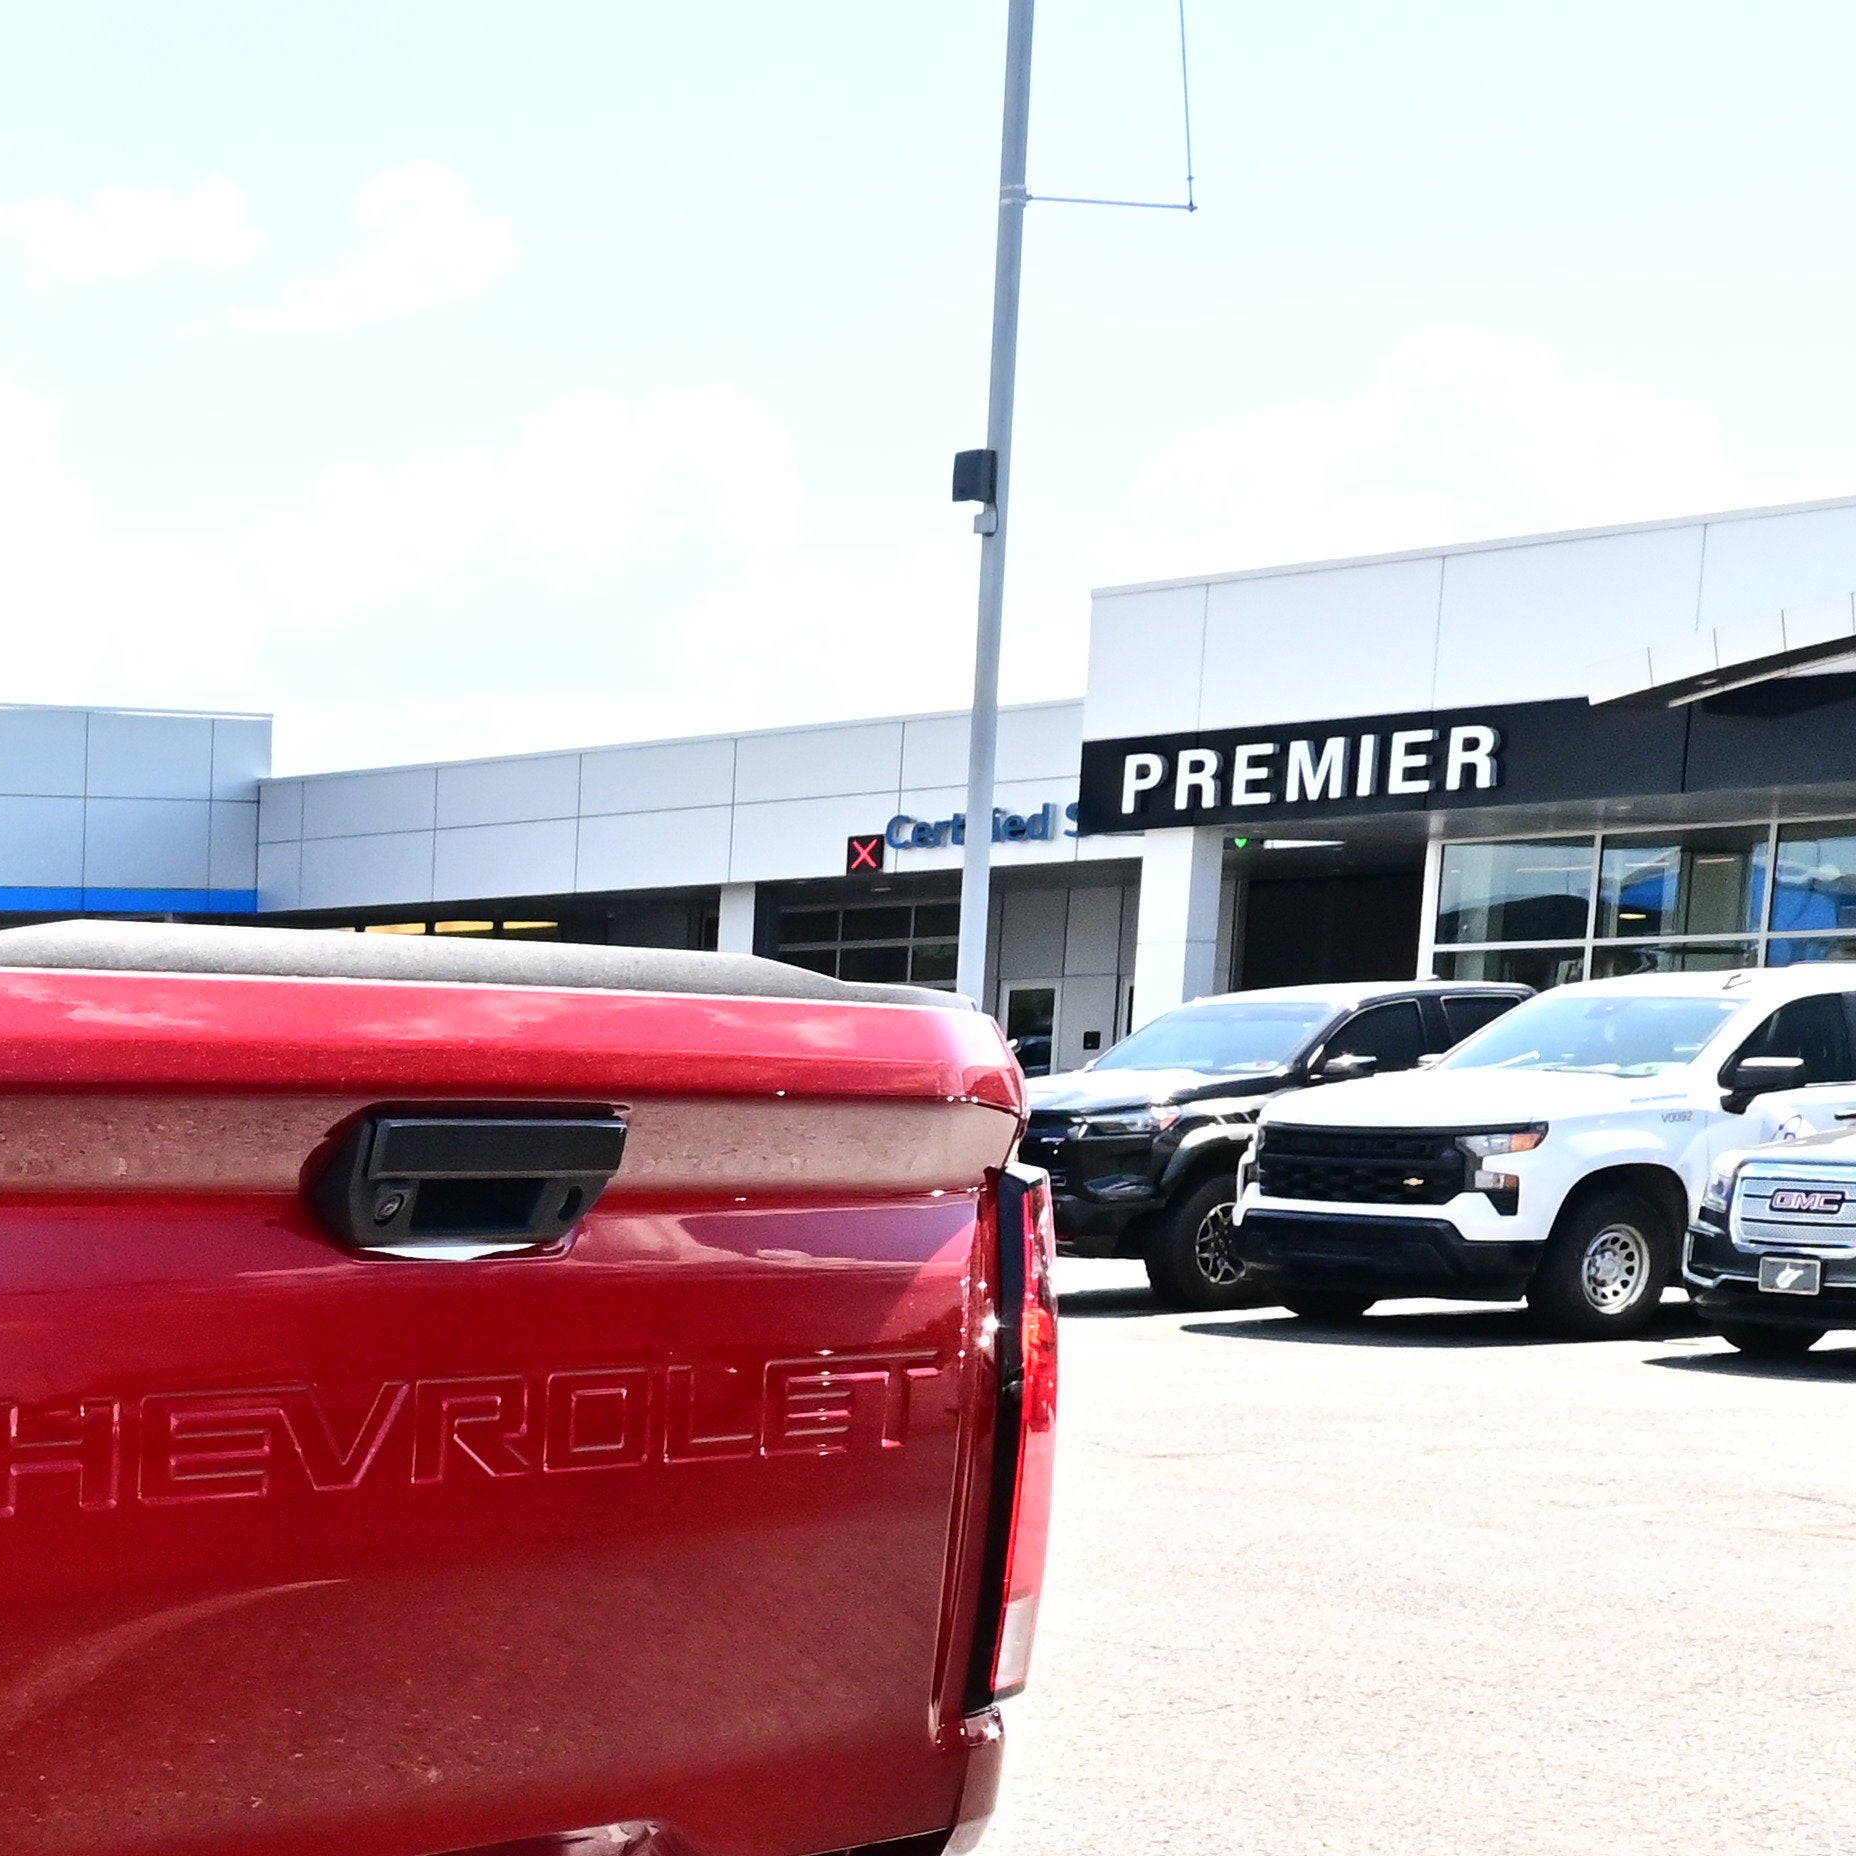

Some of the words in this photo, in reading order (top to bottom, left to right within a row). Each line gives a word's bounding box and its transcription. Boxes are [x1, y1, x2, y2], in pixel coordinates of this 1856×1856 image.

[1121, 725, 1497, 814] PREMIER
[886, 803, 1051, 849] Certied
[1772, 1190, 1843, 1211] GMC
